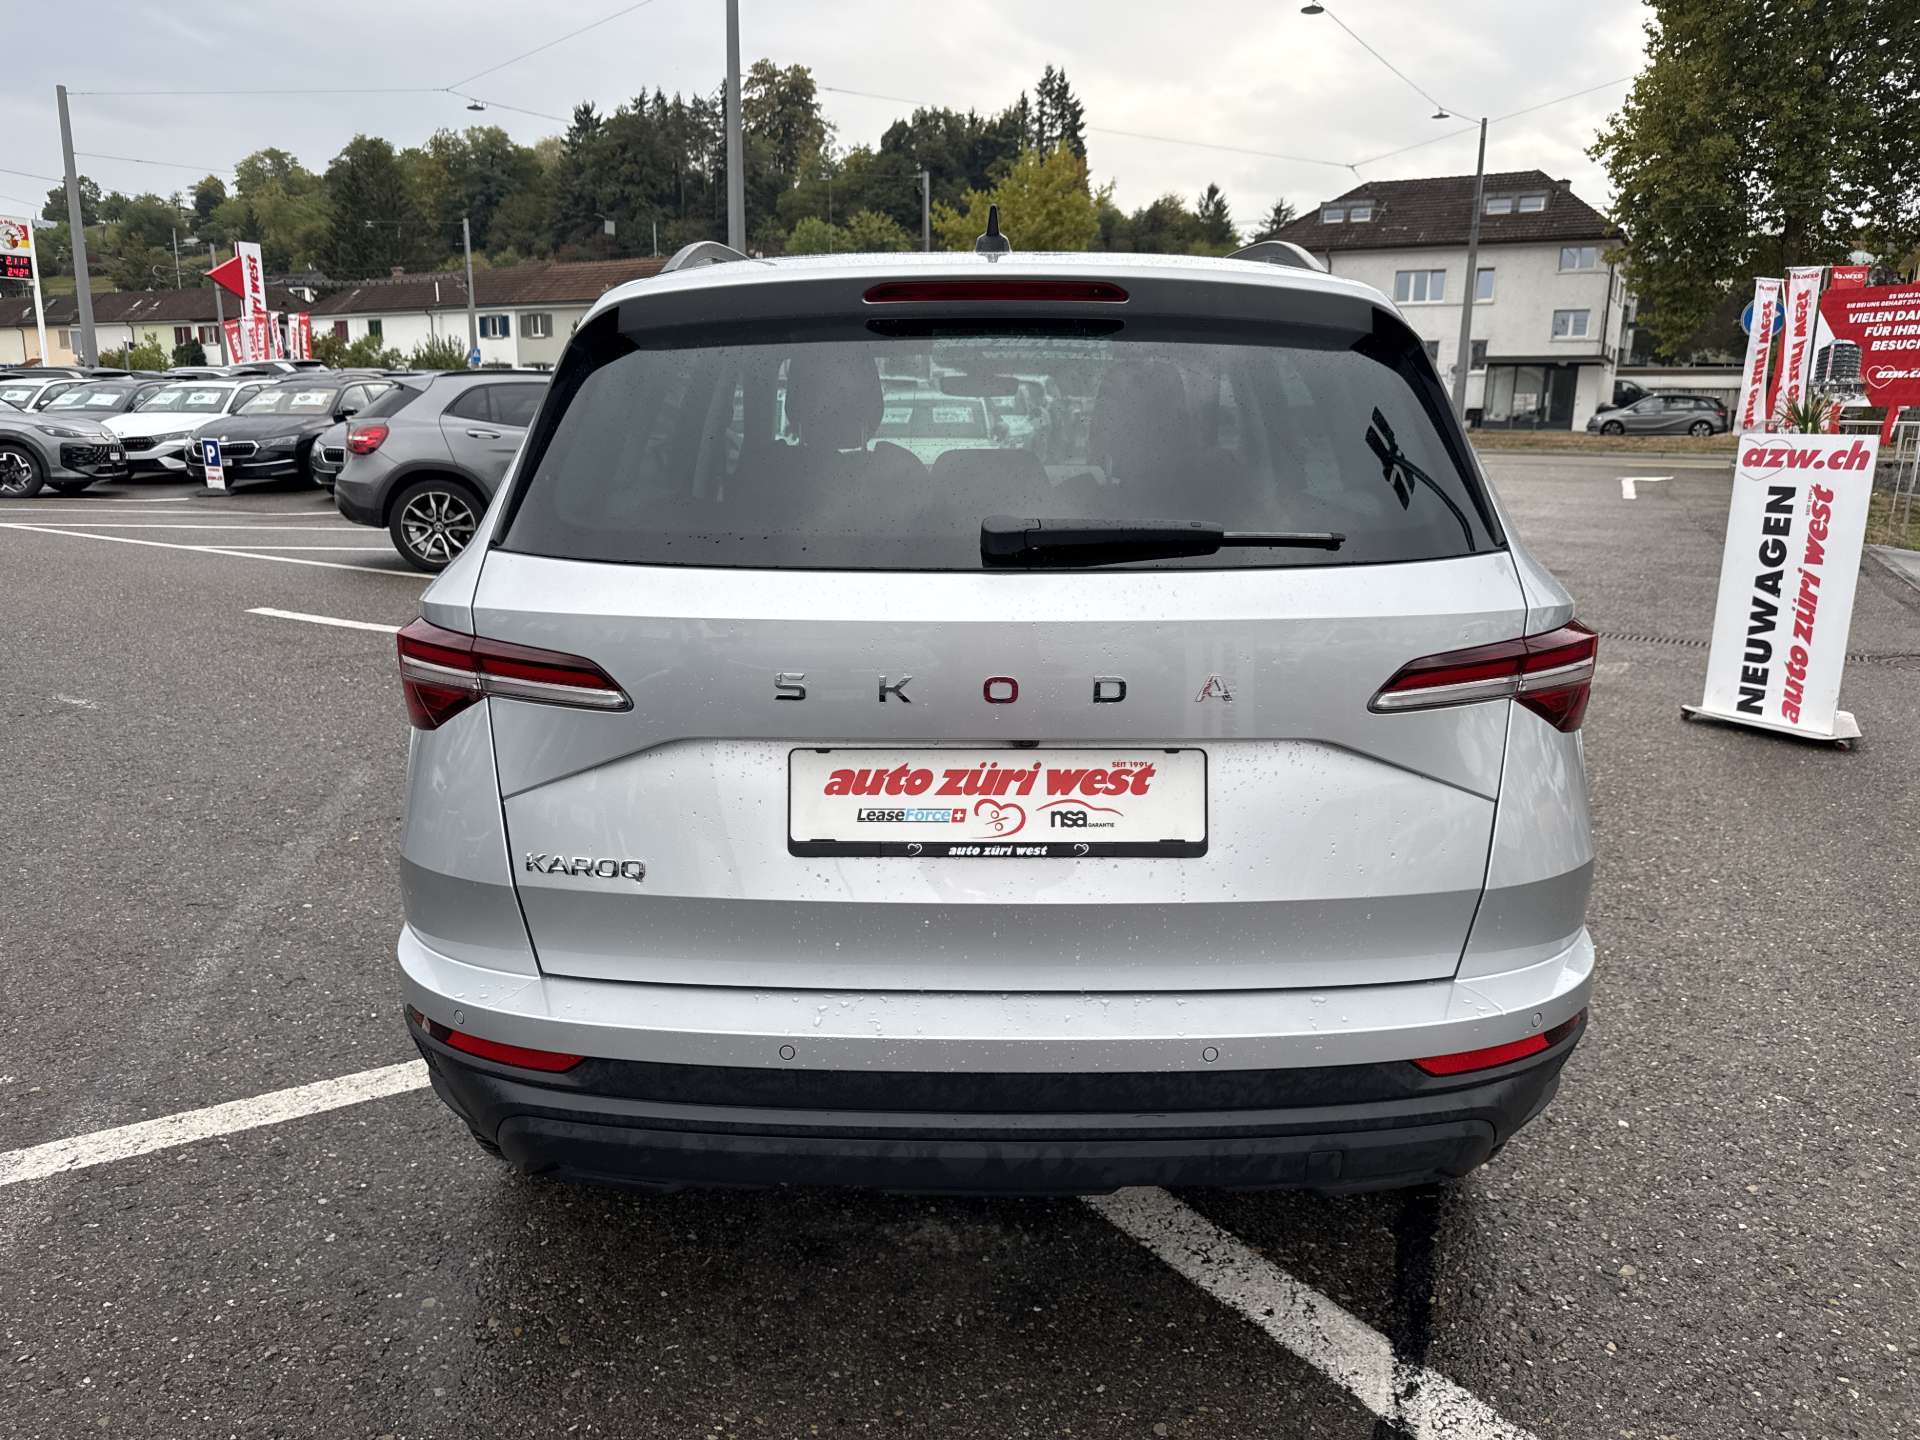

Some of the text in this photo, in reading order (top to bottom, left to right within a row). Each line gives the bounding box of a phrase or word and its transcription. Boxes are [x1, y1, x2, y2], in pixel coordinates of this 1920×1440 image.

[1848, 311, 1894, 324] VIELEN
[1864, 323, 1892, 337] FÜR
[206, 444, 216, 463] P
[1742, 440, 1871, 470] azw.ch
[1736, 486, 1796, 715] NEUWAGEN
[1781, 483, 1834, 724] auto züri west
[774, 672, 1233, 704] SKODA
[824, 762, 1156, 796] auto züri west
[857, 808, 951, 822] LeaseForce
[1050, 810, 1088, 828] nsa
[948, 845, 1048, 856] auto züri west
[526, 852, 646, 882] KAROQ
